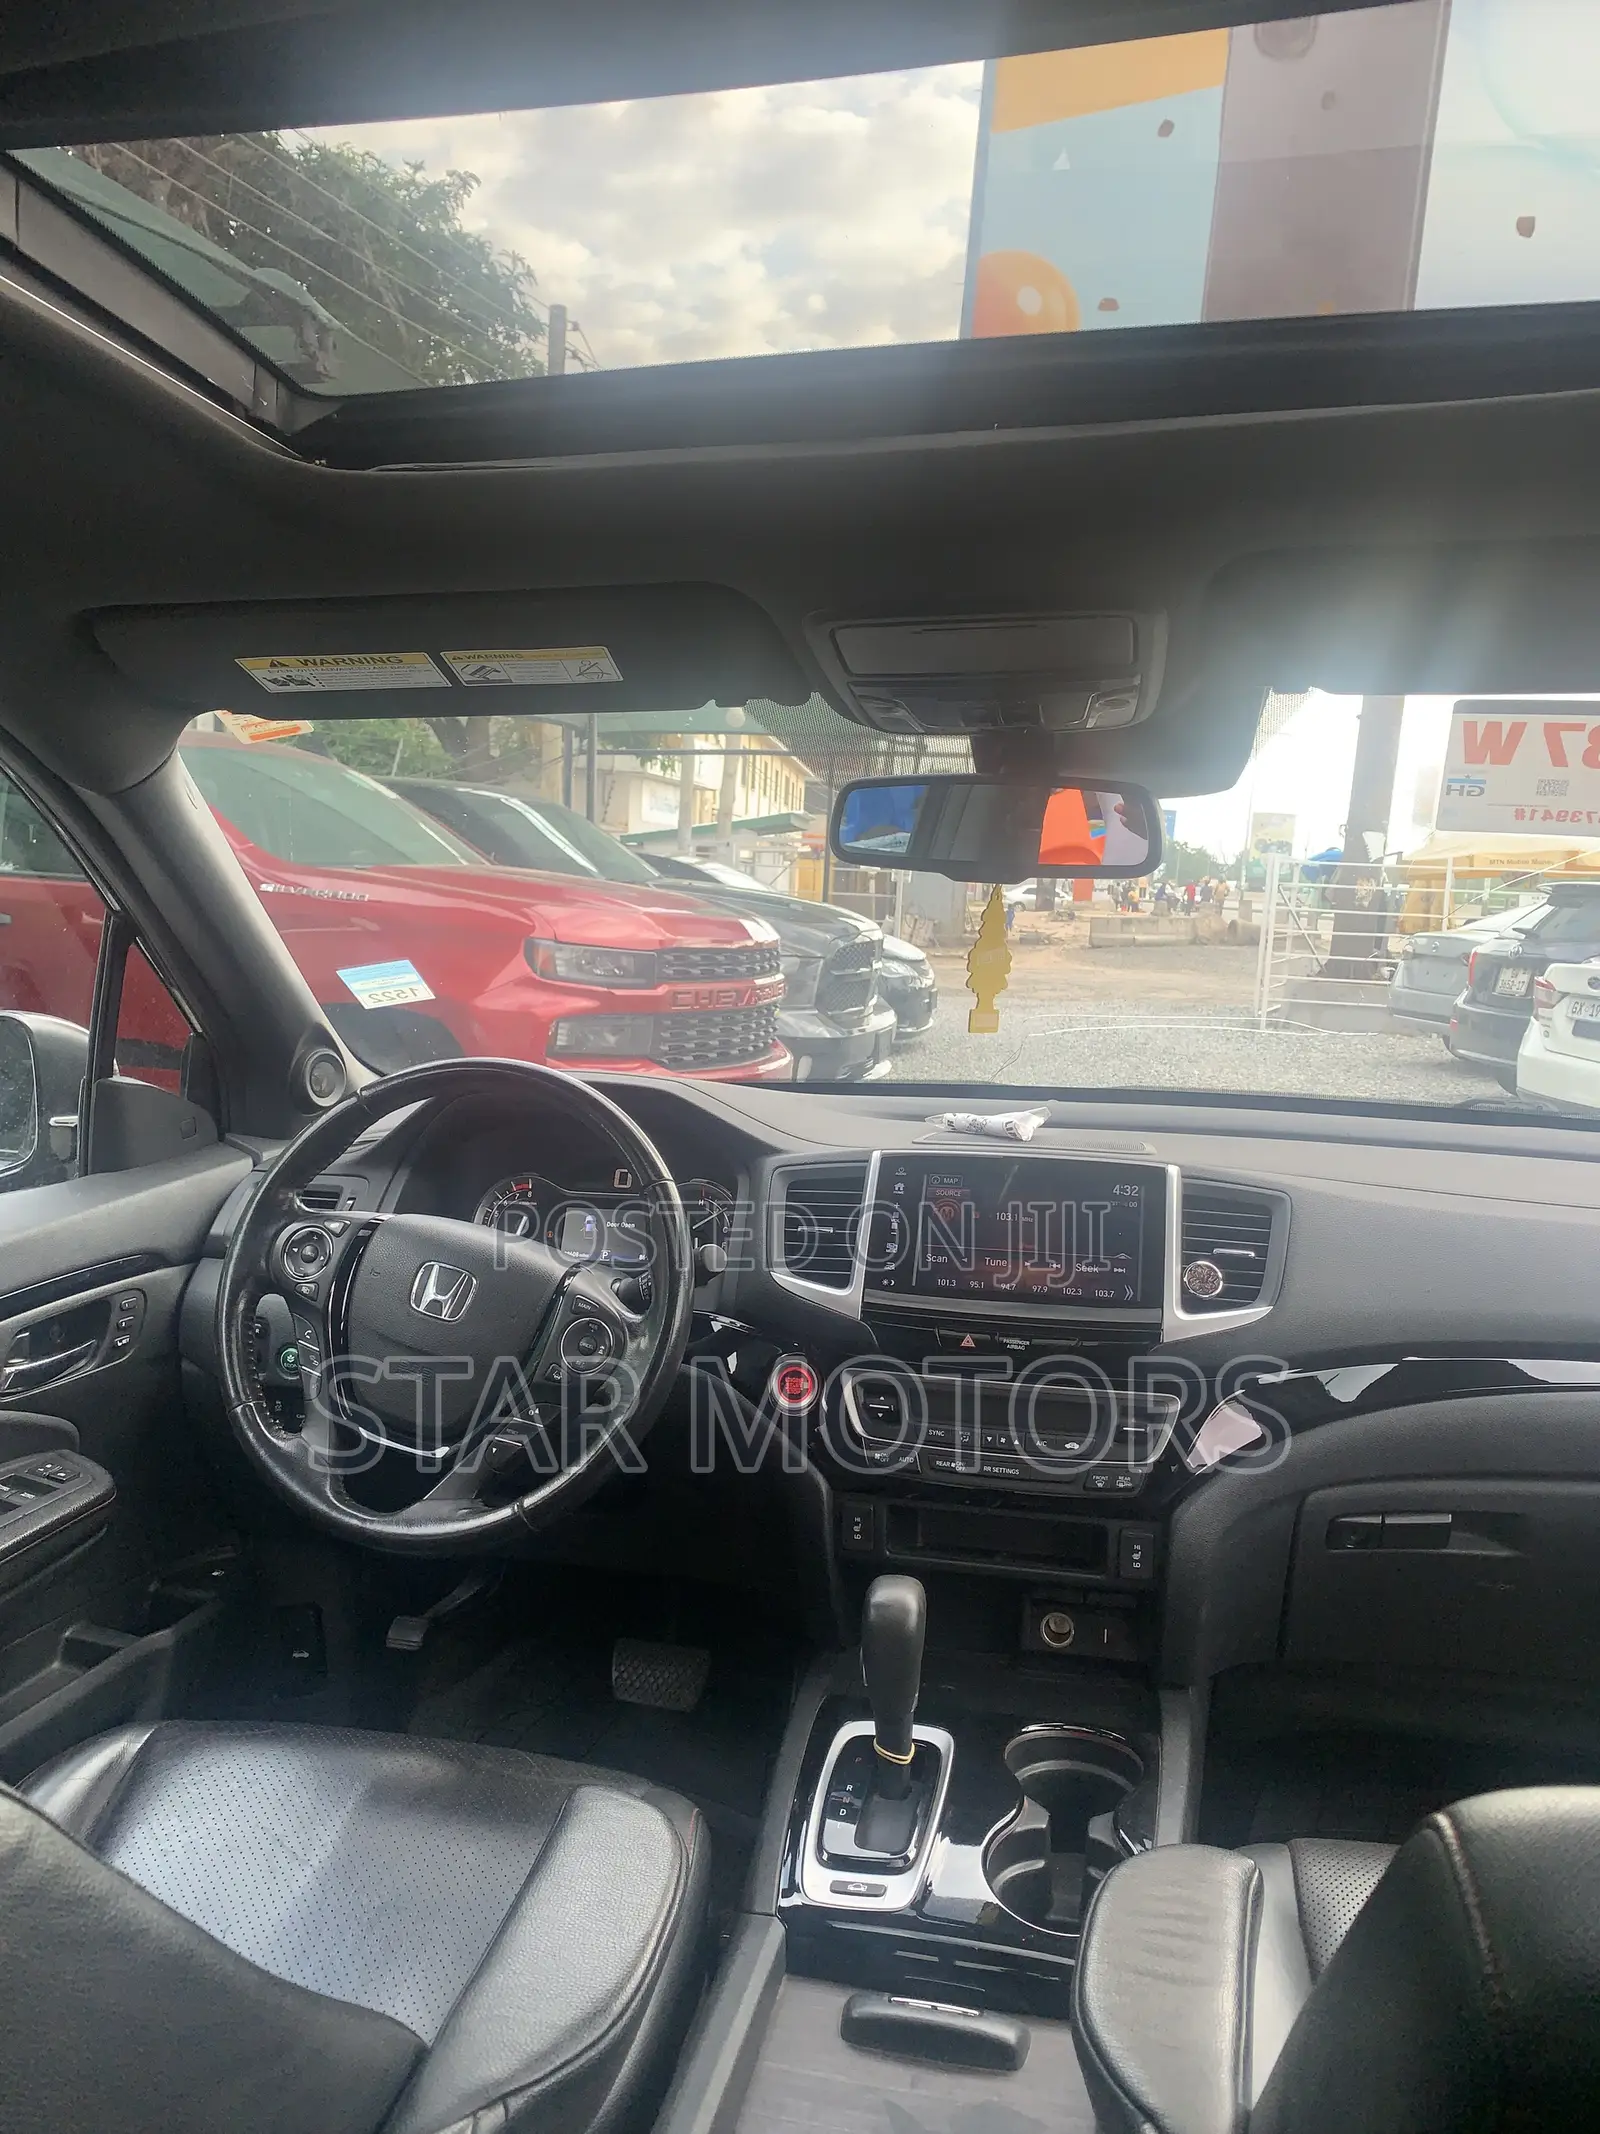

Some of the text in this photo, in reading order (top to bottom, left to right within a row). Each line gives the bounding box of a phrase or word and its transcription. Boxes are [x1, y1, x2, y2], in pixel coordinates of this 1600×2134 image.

[464, 653, 524, 661] WARNING
[295, 656, 404, 667] WARNING
[1489, 859, 1505, 867] MTN
[943, 1177, 959, 1185] MAP
[935, 1189, 962, 1197] SOURCE
[1112, 1184, 1139, 1197] 4:32
[995, 1211, 1018, 1221] 103.1
[925, 1253, 1099, 1273] Scan Tune Seek
[936, 1278, 1115, 1298] 101.3 95.1 94.7 97.9 102.3 103.7
[928, 1429, 945, 1437] SYNC
[992, 1466, 1020, 1475] SETTINGS
[846, 1784, 853, 1792] R
[839, 1808, 847, 1816] D
